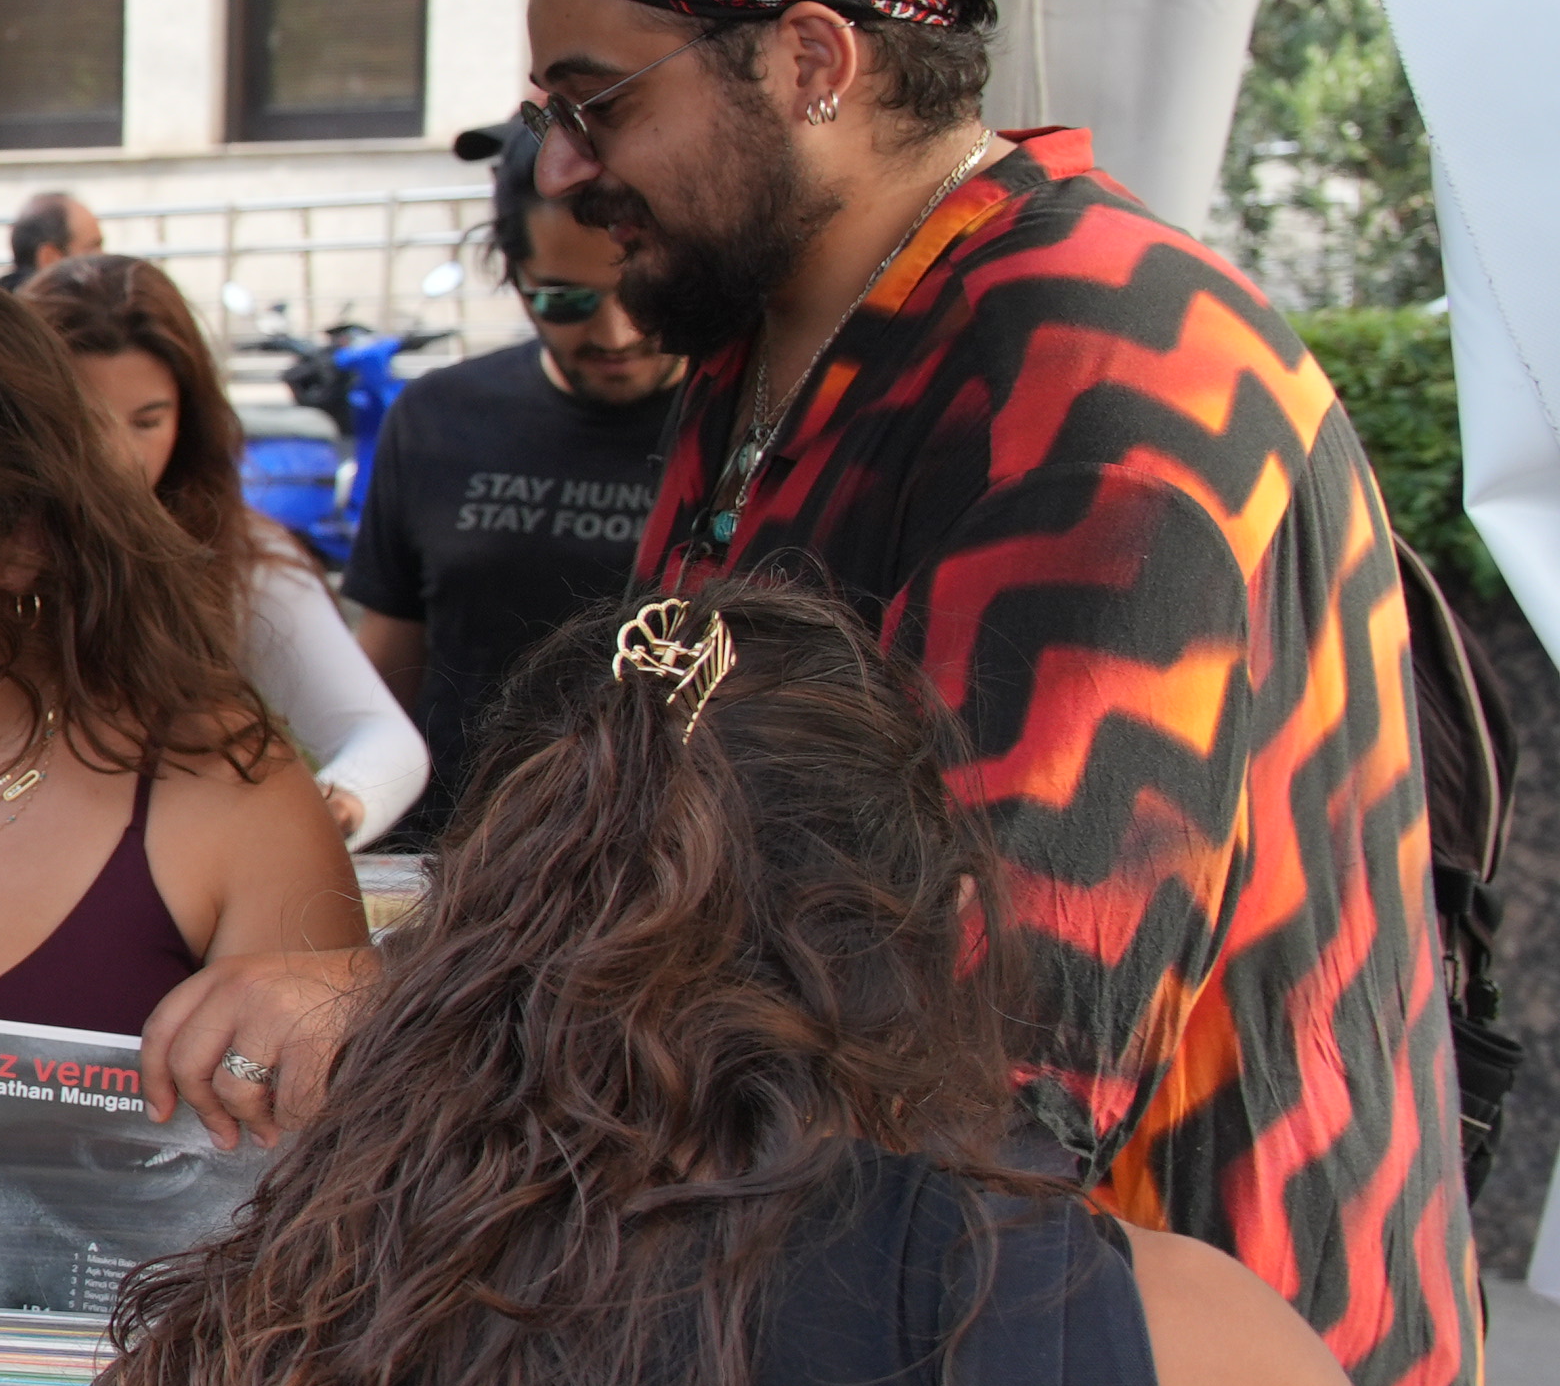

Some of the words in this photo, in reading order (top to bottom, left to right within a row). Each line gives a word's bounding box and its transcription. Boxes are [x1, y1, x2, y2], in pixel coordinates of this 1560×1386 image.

[464, 472, 555, 503] STAY
[560, 479, 657, 511] HUN
[456, 502, 548, 534] STAY
[551, 510, 646, 543] FOOL
[32, 1057, 141, 1095] verm
[60, 1086, 145, 1113] Mungan
[88, 1242, 99, 1253] A
